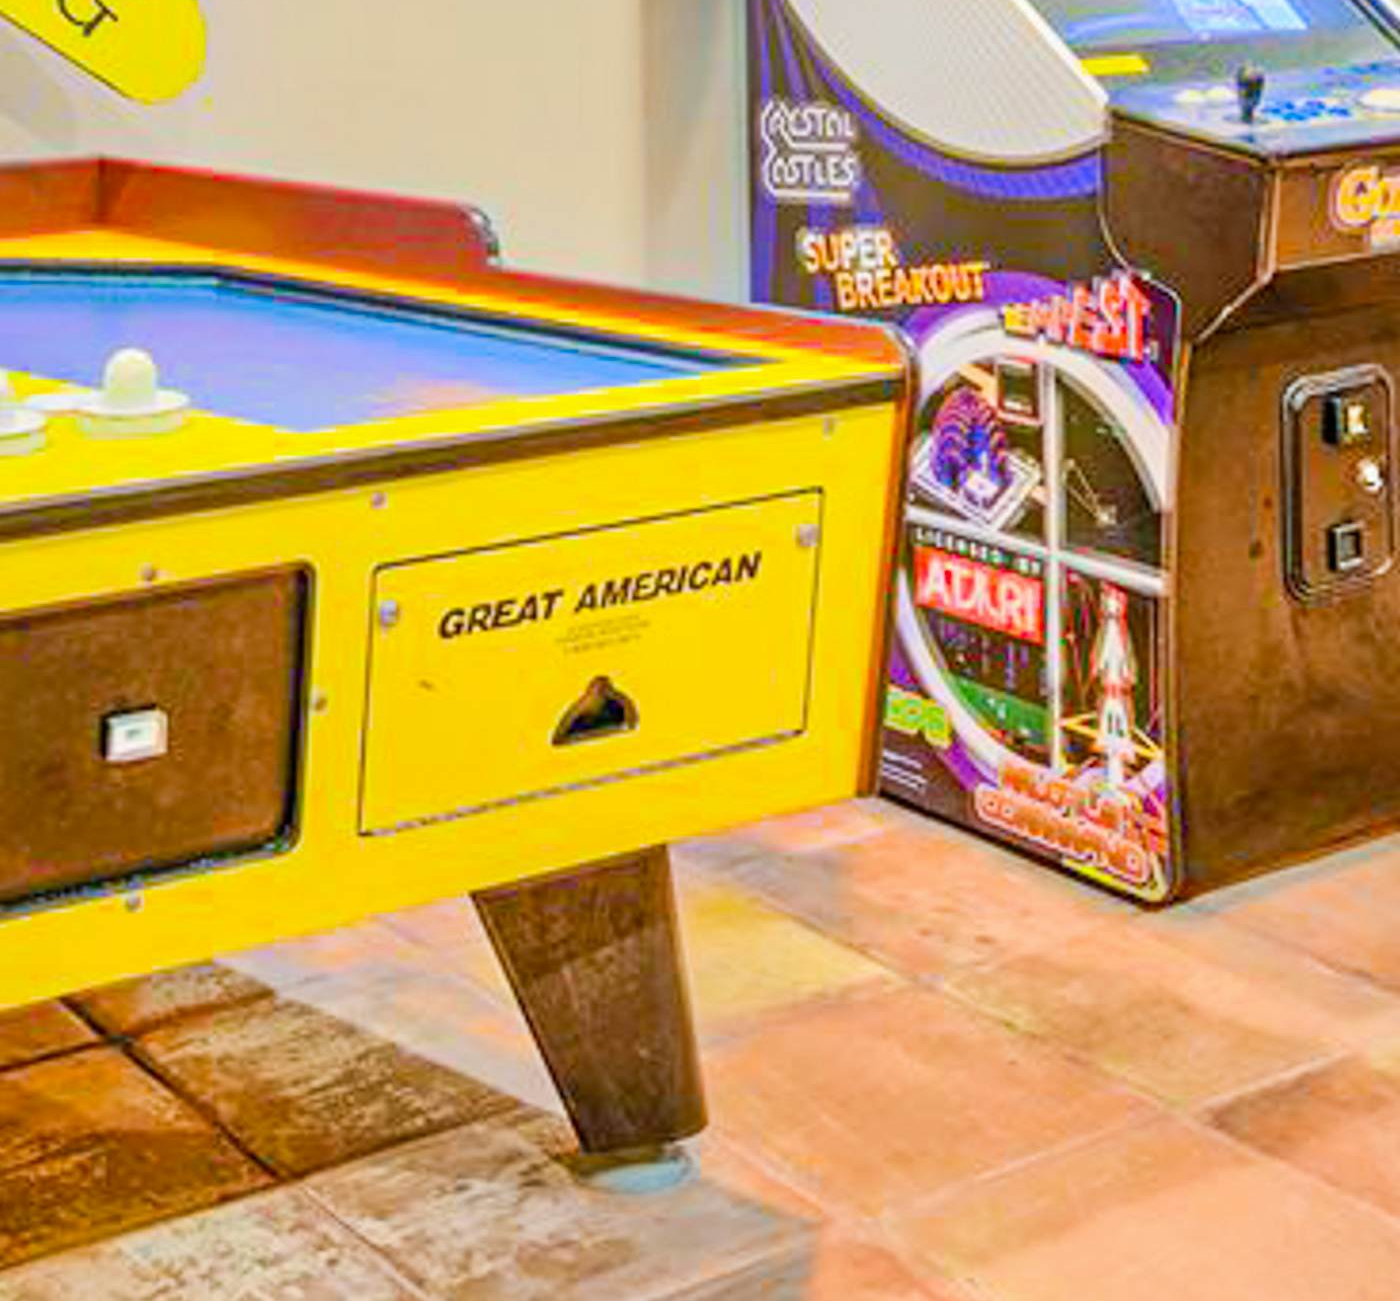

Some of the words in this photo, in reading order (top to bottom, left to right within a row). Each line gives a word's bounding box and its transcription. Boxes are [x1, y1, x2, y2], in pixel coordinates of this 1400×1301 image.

[799, 225, 898, 274] SUPER
[835, 261, 989, 310] BREAKOUT
[438, 589, 564, 638] GREAT
[574, 551, 763, 614] AMERICAN
[915, 557, 1038, 635] ATARI
